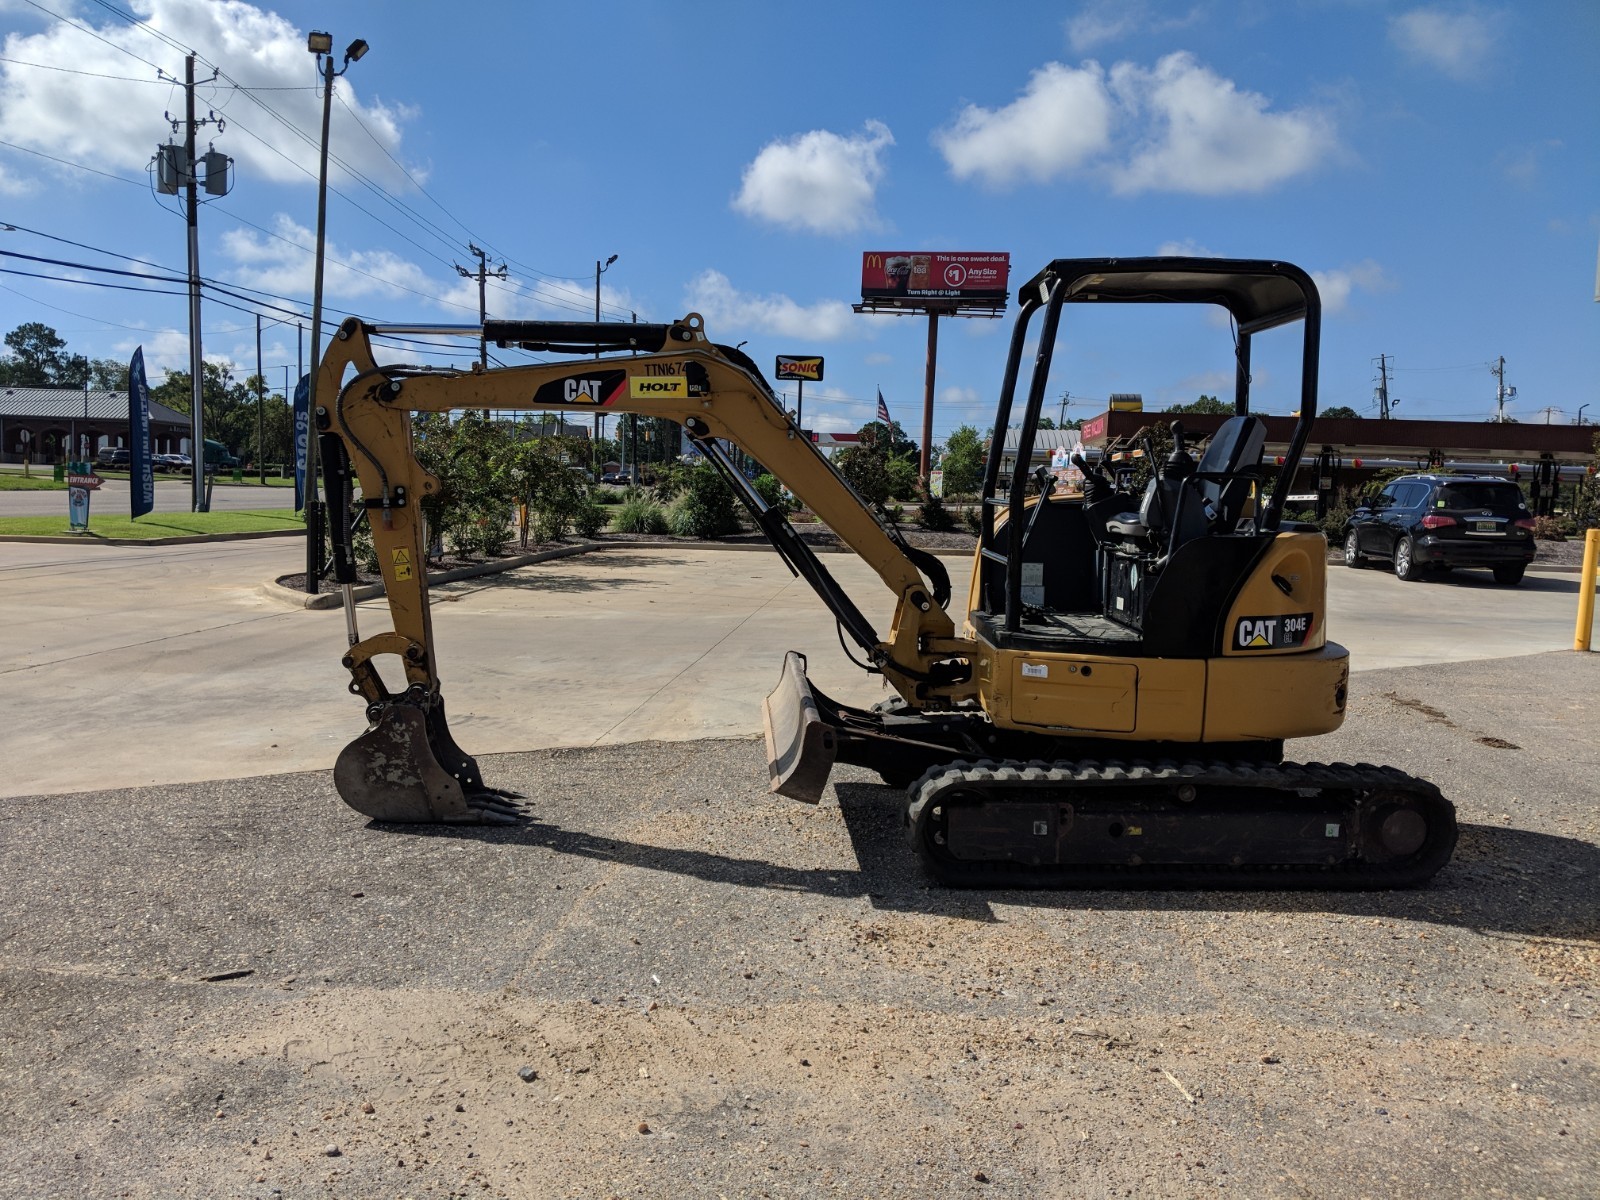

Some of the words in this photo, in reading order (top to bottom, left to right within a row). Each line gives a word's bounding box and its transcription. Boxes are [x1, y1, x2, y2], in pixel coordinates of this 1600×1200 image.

[913, 265, 927, 274] tea
[968, 268, 983, 276] Any
[948, 269, 960, 282] $1
[921, 289, 937, 297] Right
[945, 289, 961, 297] Light
[782, 362, 818, 373] SONIC
[564, 378, 602, 403] CAT
[639, 382, 682, 392] HOLT
[69, 476, 99, 484] ENTRANCE
[142, 465, 154, 504] WASH
[1239, 620, 1277, 647] CAT
[1284, 617, 1306, 632] 304E
